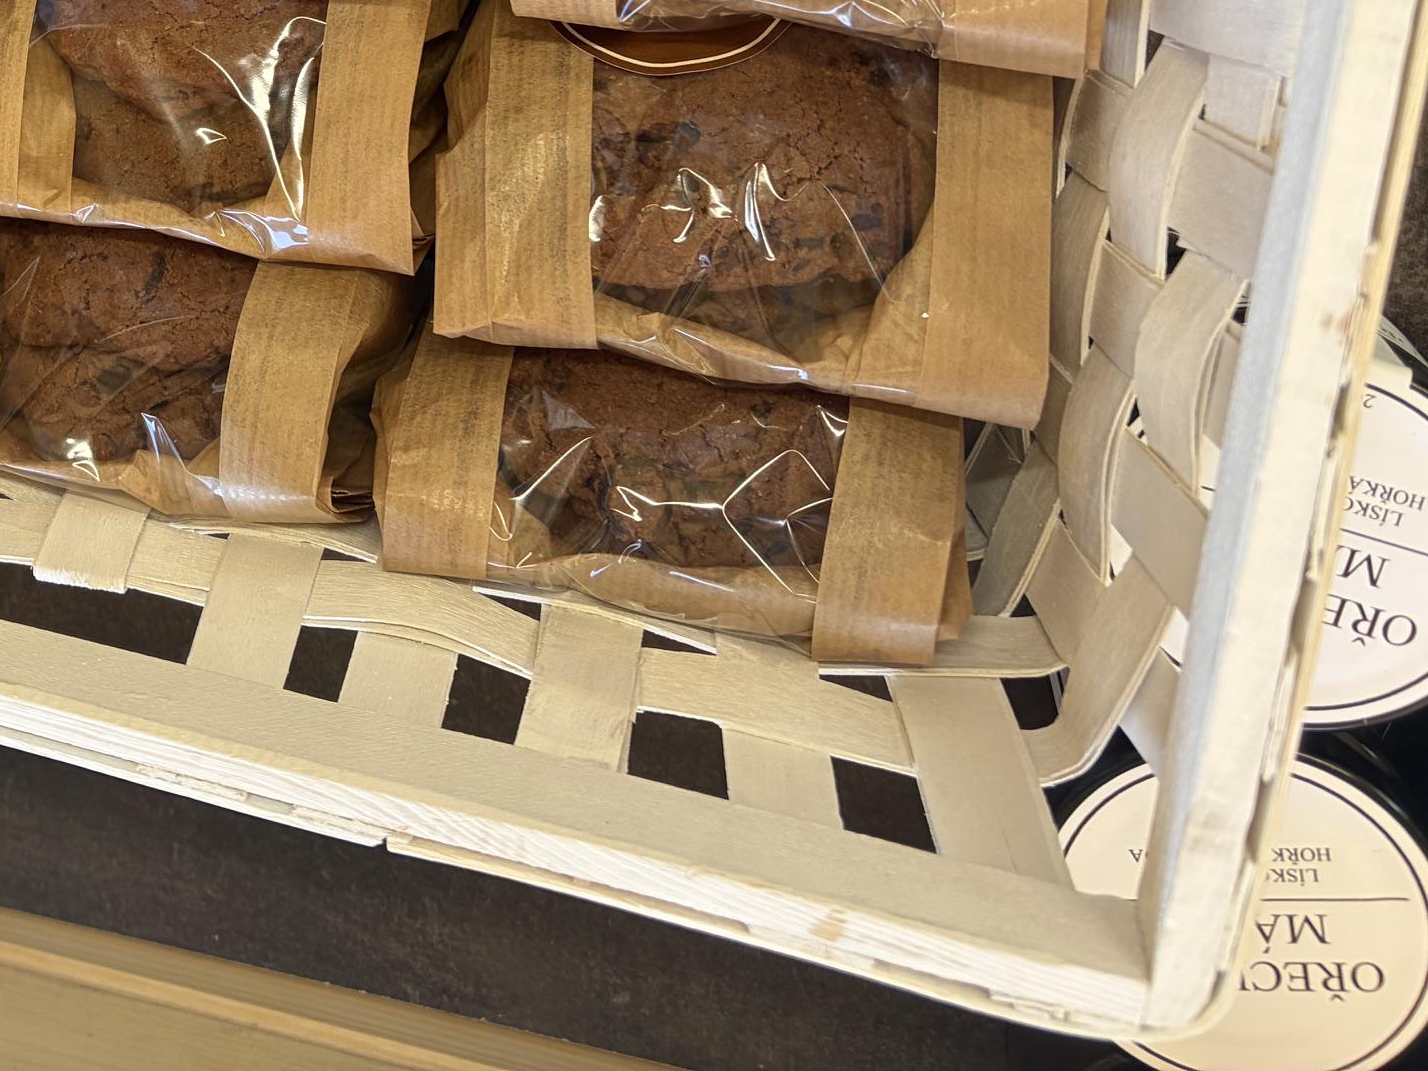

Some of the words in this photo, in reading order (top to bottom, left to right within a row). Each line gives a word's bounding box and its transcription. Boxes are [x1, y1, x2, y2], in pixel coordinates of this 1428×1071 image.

[1348, 475, 1426, 511] HOŘKÁ
[1337, 544, 1391, 589] M
[1266, 868, 1320, 886] LÍSK
